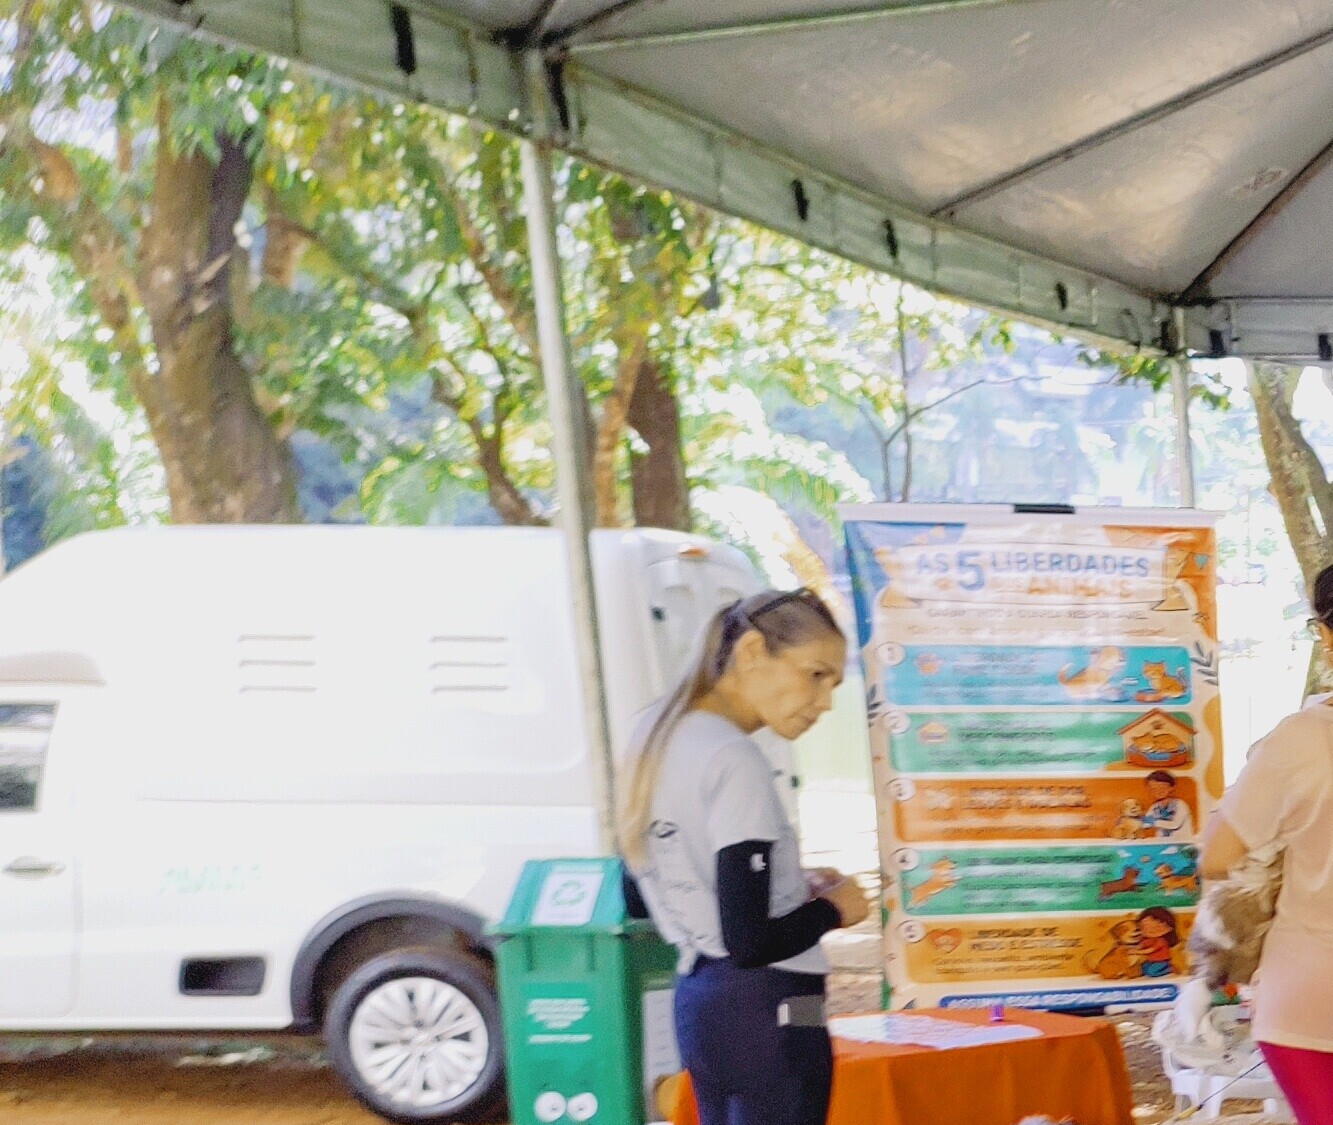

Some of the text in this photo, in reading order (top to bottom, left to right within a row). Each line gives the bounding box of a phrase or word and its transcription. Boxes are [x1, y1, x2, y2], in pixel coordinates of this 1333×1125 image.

[917, 553, 949, 573] AS
[956, 550, 985, 591] 5
[990, 553, 1149, 577] LIBERDADES
